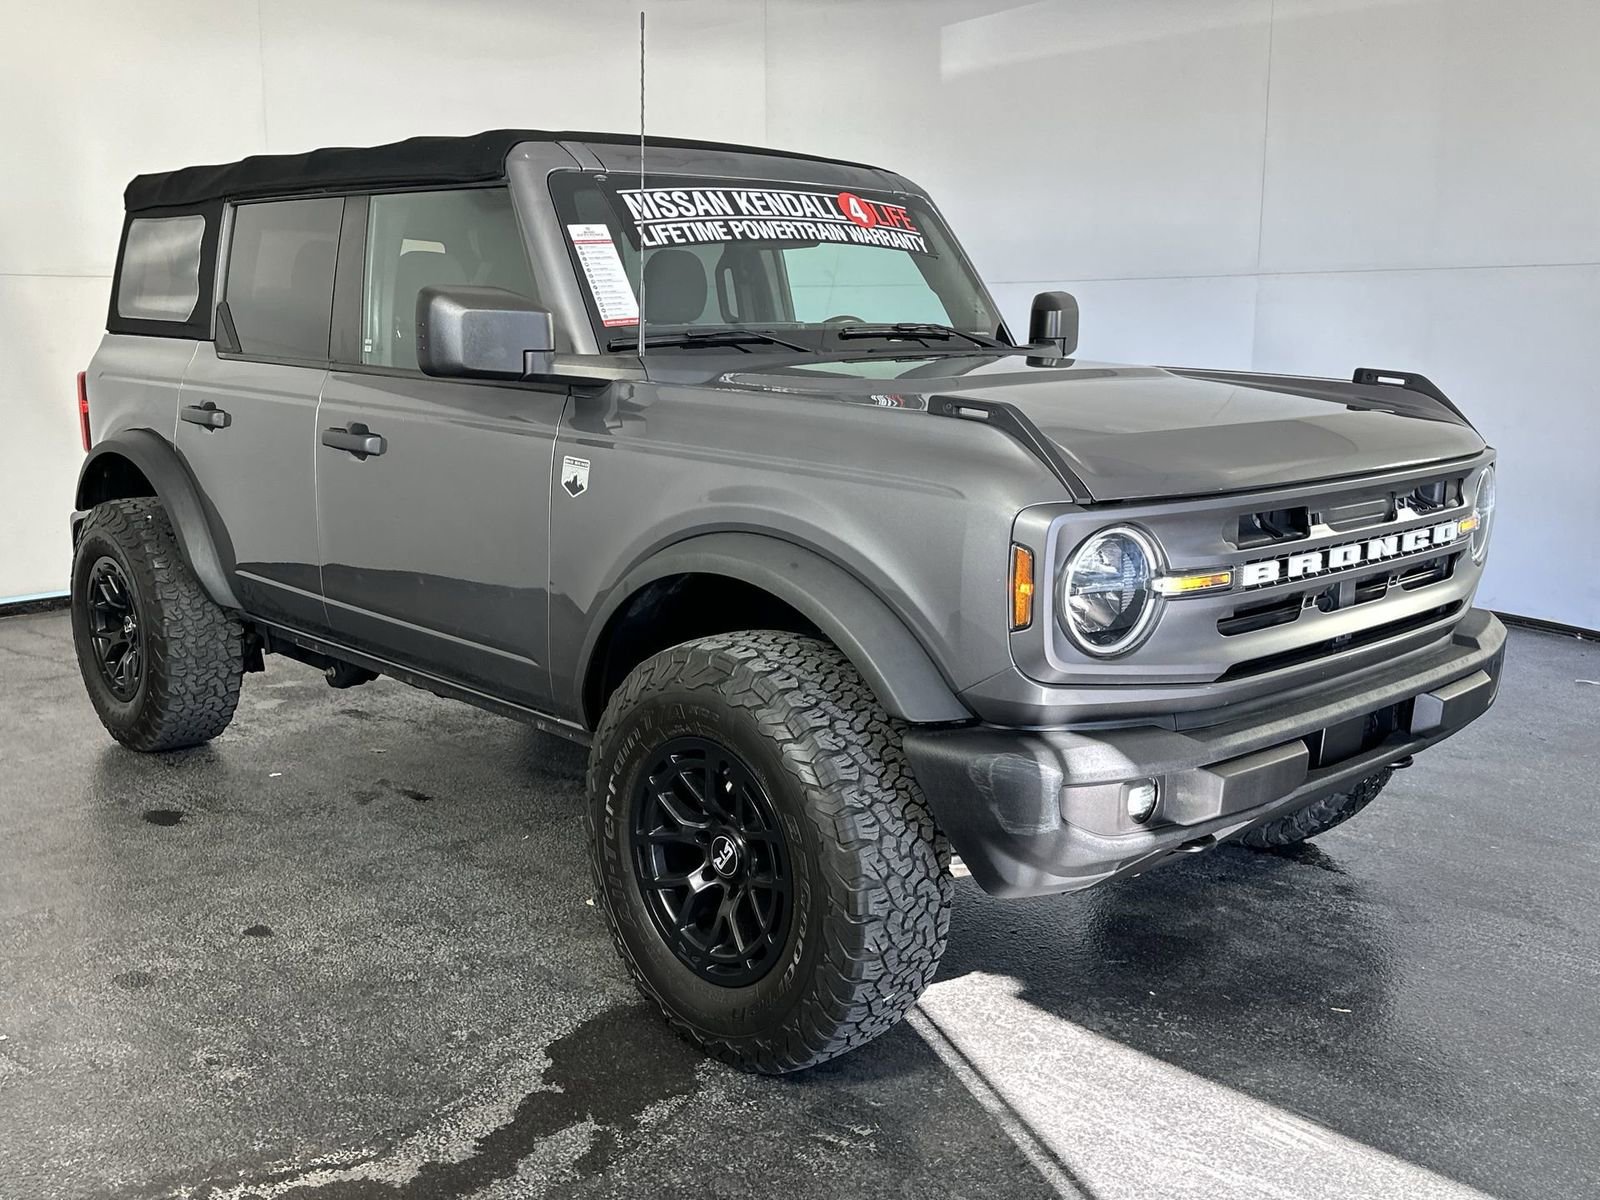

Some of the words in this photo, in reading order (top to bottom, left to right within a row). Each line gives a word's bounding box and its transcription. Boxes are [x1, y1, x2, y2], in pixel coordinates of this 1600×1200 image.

[621, 191, 734, 220] NISSAN
[731, 191, 848, 221] KENDALL
[848, 197, 868, 223] 4
[868, 203, 917, 232] LIFE
[636, 221, 733, 247] LIFETIME
[728, 220, 849, 242] POWERTRAIN
[844, 224, 929, 254] WARRANTY
[1242, 520, 1458, 587] BRONCO
